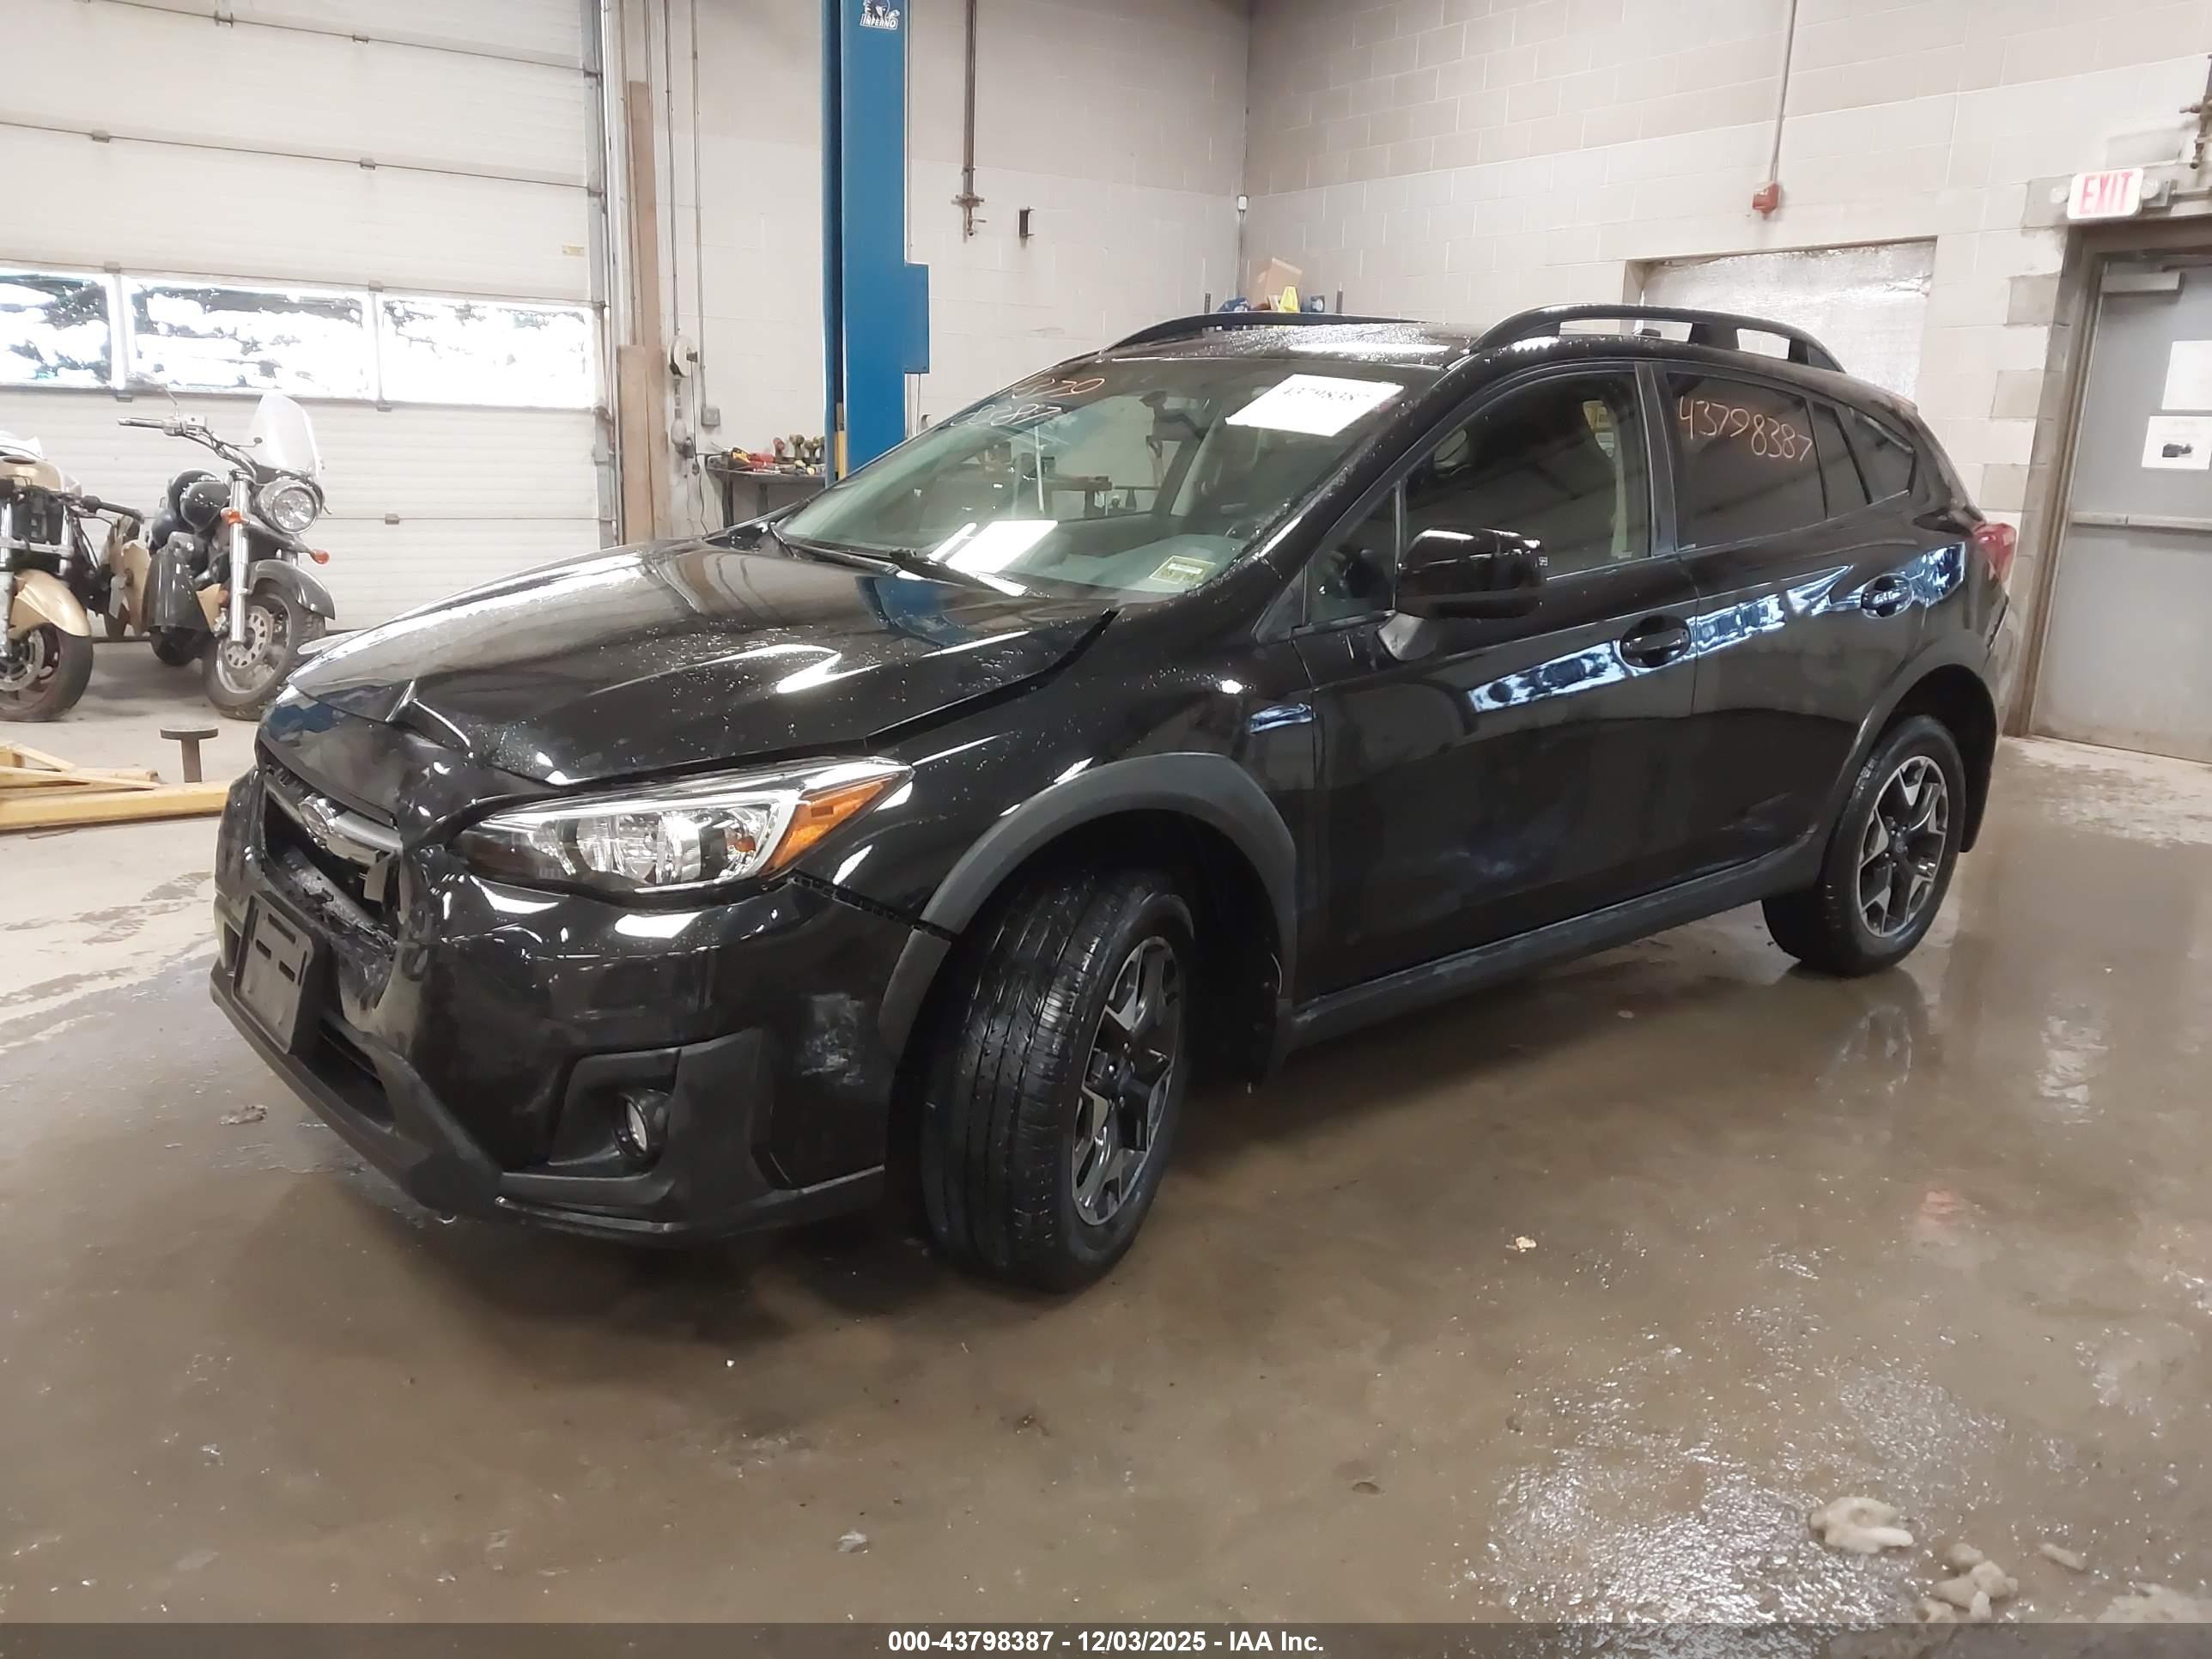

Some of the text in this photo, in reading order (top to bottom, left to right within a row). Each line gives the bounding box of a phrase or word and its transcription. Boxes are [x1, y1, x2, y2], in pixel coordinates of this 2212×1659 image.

[862, 15, 897, 28] INFERNO
[2079, 172, 2134, 215] EXIT
[1679, 395, 1814, 462] 43798387
